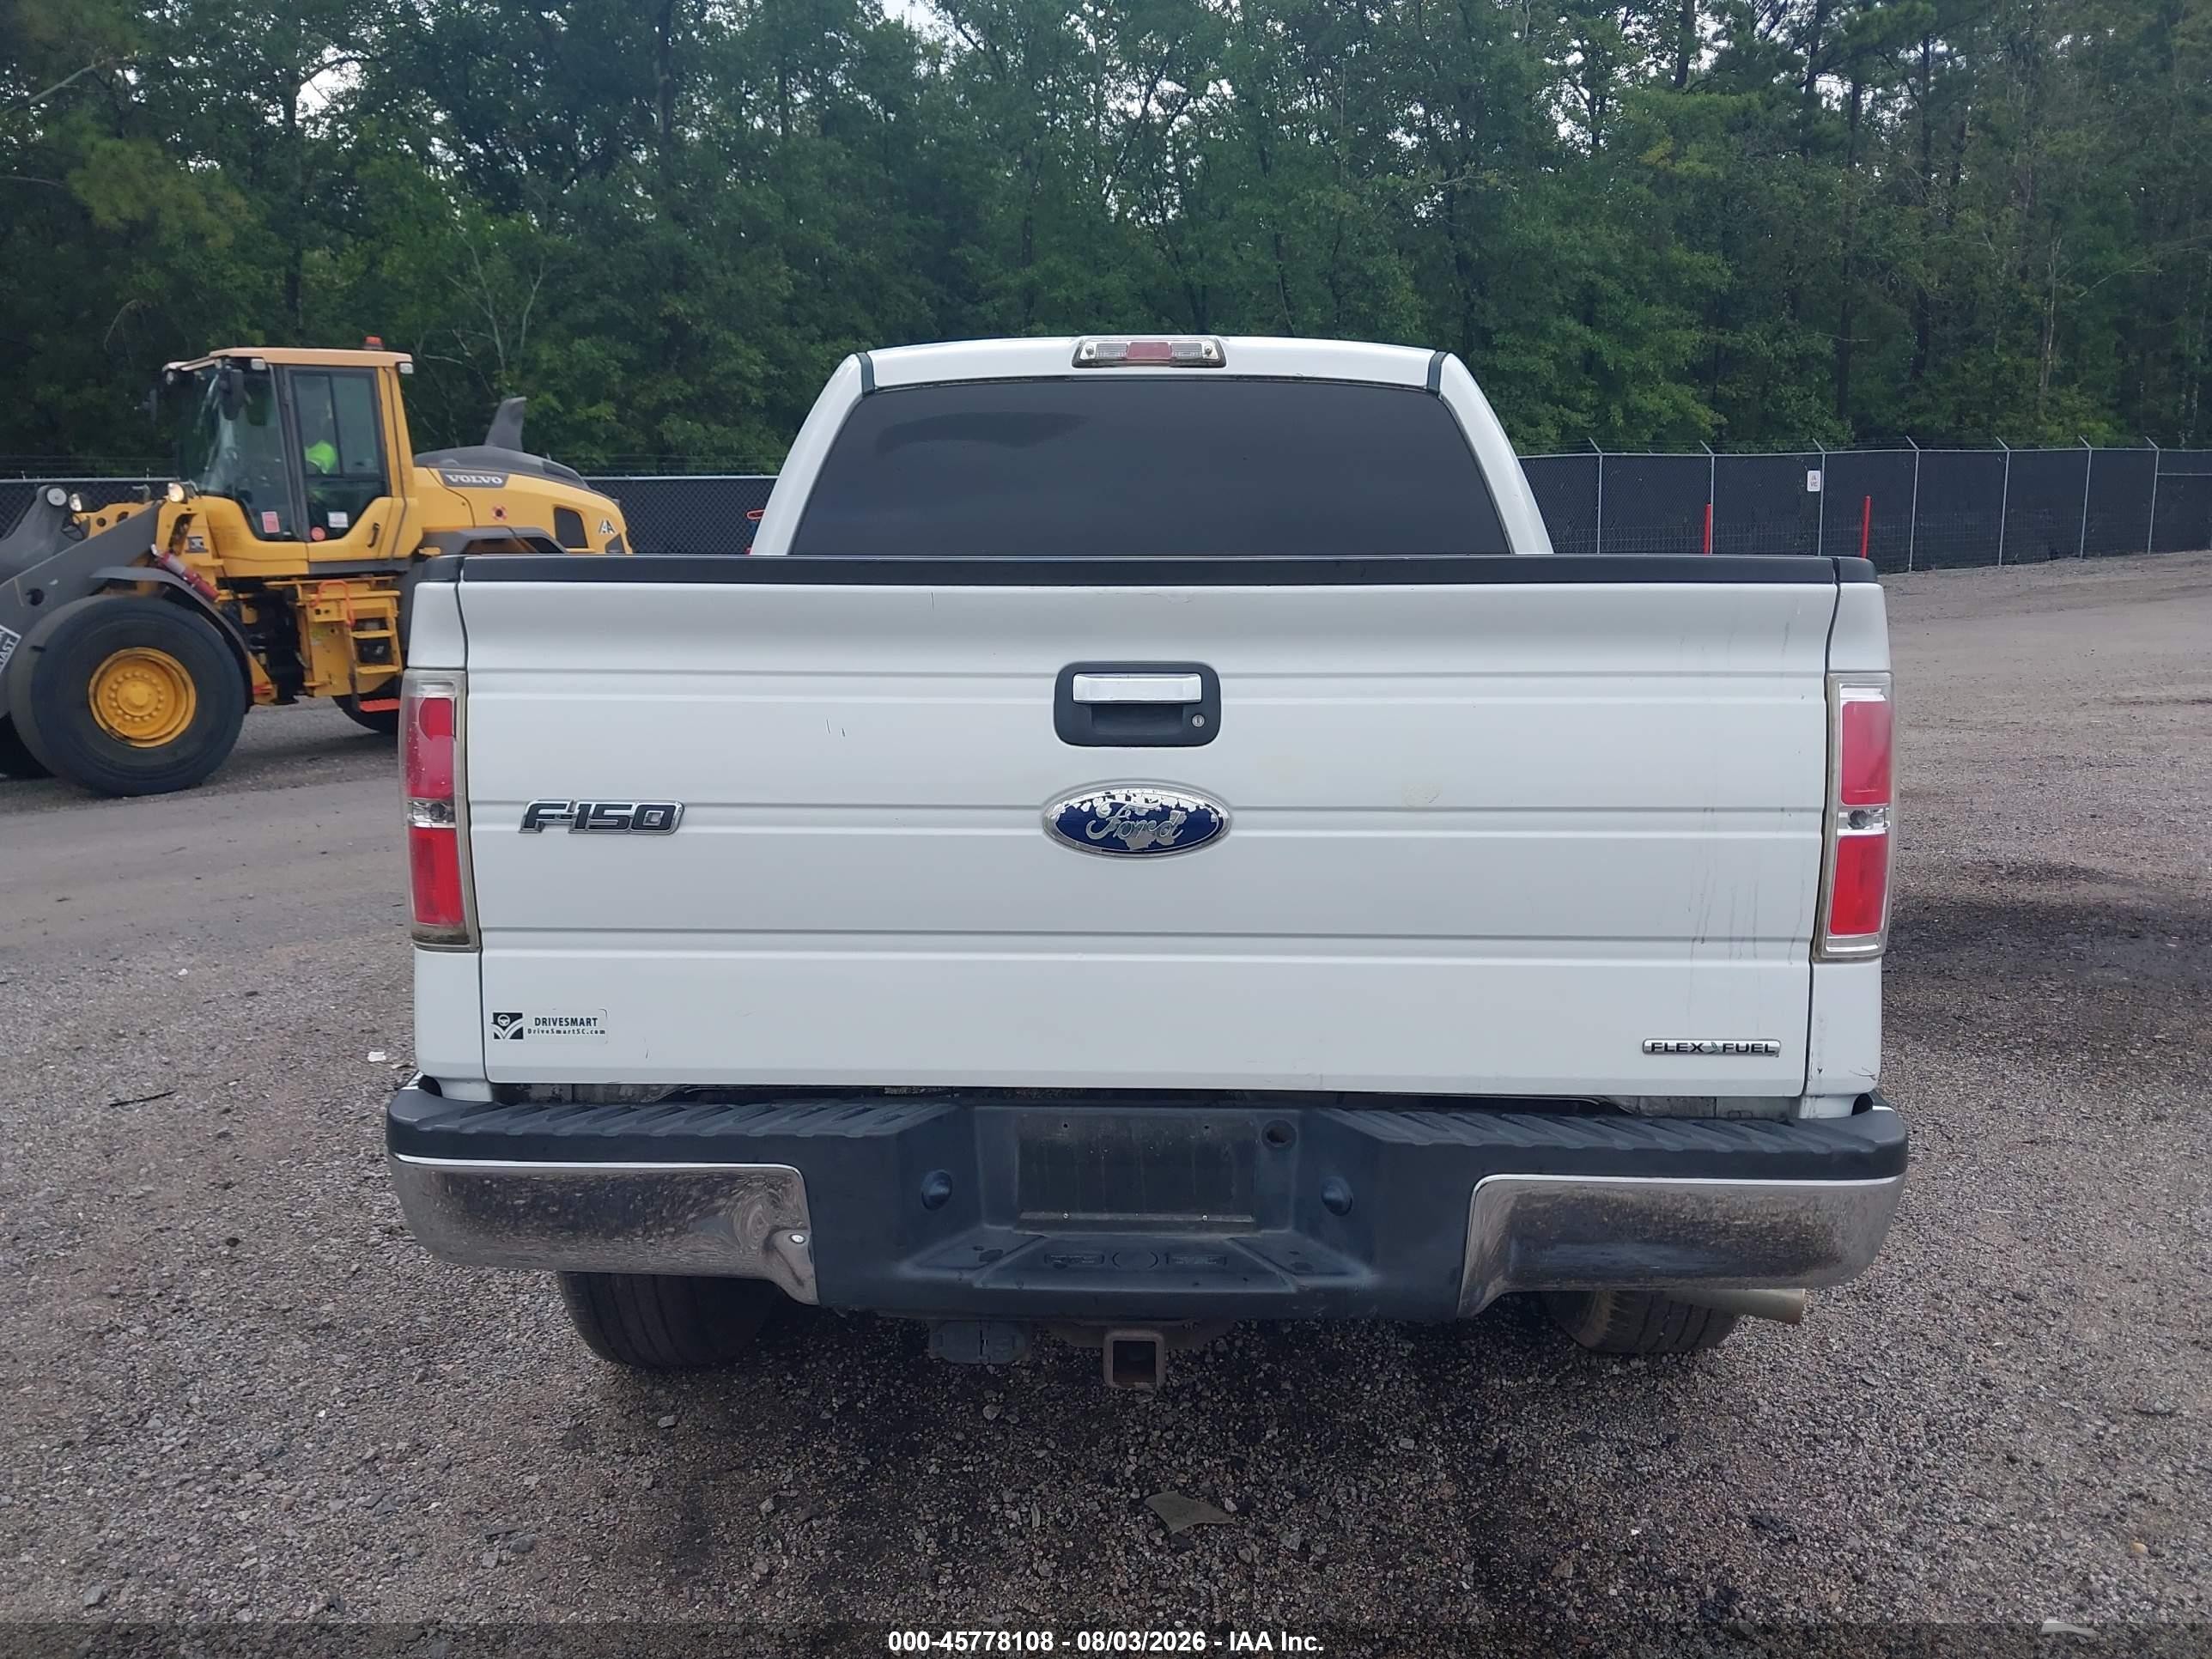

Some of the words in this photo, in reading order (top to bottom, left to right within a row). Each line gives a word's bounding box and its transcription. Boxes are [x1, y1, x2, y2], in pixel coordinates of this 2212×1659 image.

[446, 474, 503, 484] VOLVO
[519, 799, 684, 835] F-150
[534, 1017, 599, 1027] DRIVESMART
[1650, 1042, 1705, 1053] FLEX
[1723, 1042, 1777, 1054] FUEL
